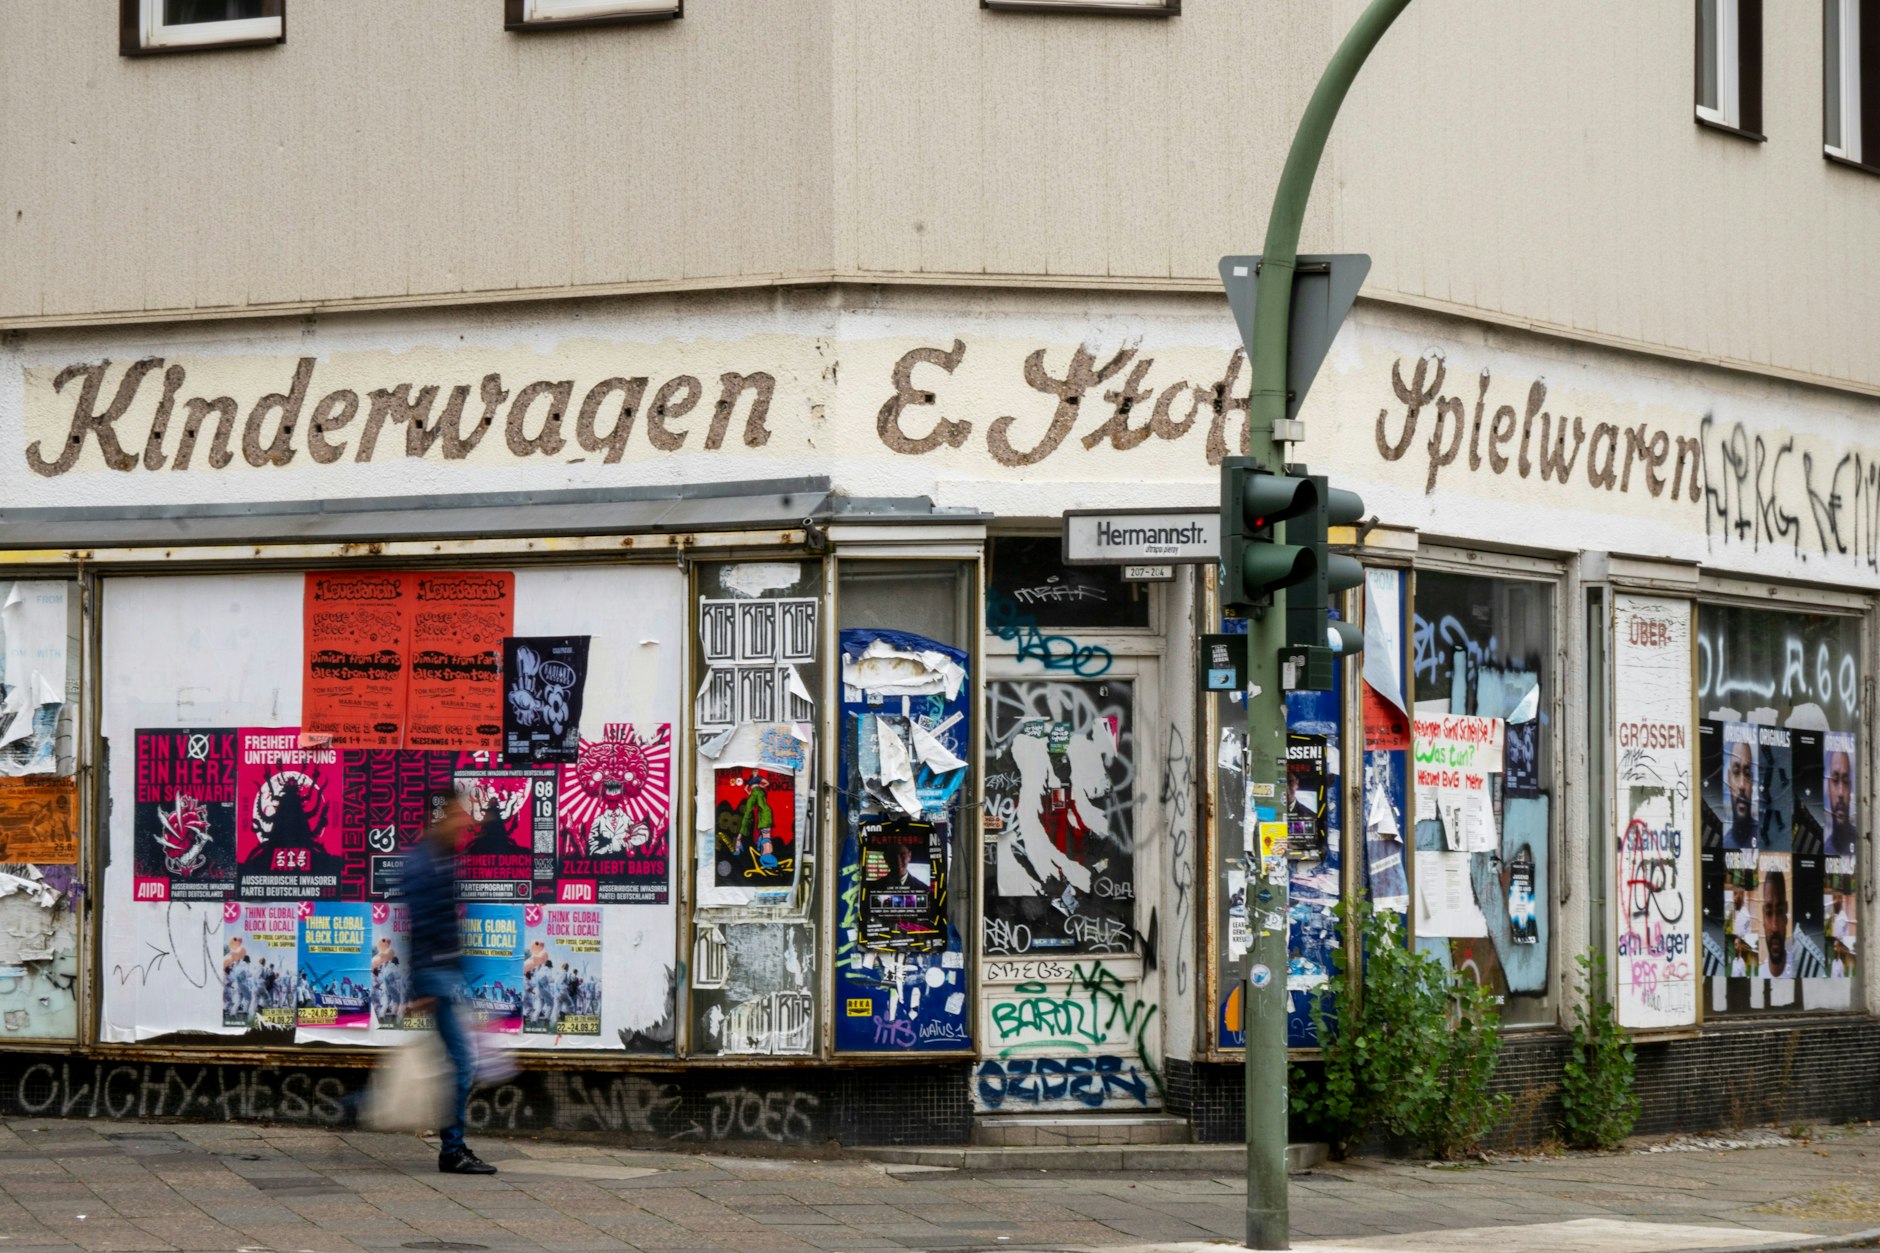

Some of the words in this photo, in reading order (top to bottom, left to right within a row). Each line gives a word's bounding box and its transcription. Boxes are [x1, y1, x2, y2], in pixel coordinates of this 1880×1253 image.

[25, 356, 777, 477] Kinderwagen
[1375, 350, 1702, 503] Spielwaren
[1097, 521, 1207, 546] Hermannstr.
[1619, 716, 1686, 749] GRÖSSEN
[1759, 728, 1791, 747] ORIGINALS
[138, 735, 170, 758] EIN
[245, 735, 295, 749] FREIHEIT
[245, 751, 336, 764] UNTERWERFUNG
[1414, 740, 1445, 764] Was
[1449, 744, 1475, 767] tun?
[138, 761, 170, 784] EIN
[176, 760, 235, 784] HERZ
[138, 785, 162, 802] EIN
[165, 784, 235, 802] SCHWARM
[342, 750, 366, 902] LITERATU
[498, 855, 532, 866] DURCH
[594, 861, 625, 874] LIEBT
[628, 861, 664, 875] BABYS
[241, 876, 298, 886] AUSSERIRDISCHE
[299, 876, 337, 886] INVASOREN
[138, 882, 165, 898] AIPD
[241, 887, 264, 897] PARTEI
[266, 886, 320, 897] DEUTSCHLANDS
[562, 884, 591, 900] AIPD
[245, 907, 266, 918] THINK
[269, 908, 295, 919] GLOBAL
[547, 911, 569, 923] THINK
[572, 911, 601, 924] GLOBAL
[244, 920, 266, 931] BLOCK
[269, 920, 295, 931] LOCAL!
[305, 916, 331, 929] THINK
[333, 917, 364, 930] GLOBAL
[485, 919, 517, 933] GLOBAL
[547, 924, 569, 936] BLOCK
[572, 924, 599, 936] LOCAL!
[305, 930, 332, 944] BLOCK
[334, 931, 364, 944] LOCAL!
[486, 934, 516, 948] LOCAL!
[848, 1000, 870, 1008] REKA
[557, 1023, 599, 1033] 22.-24.09.23
